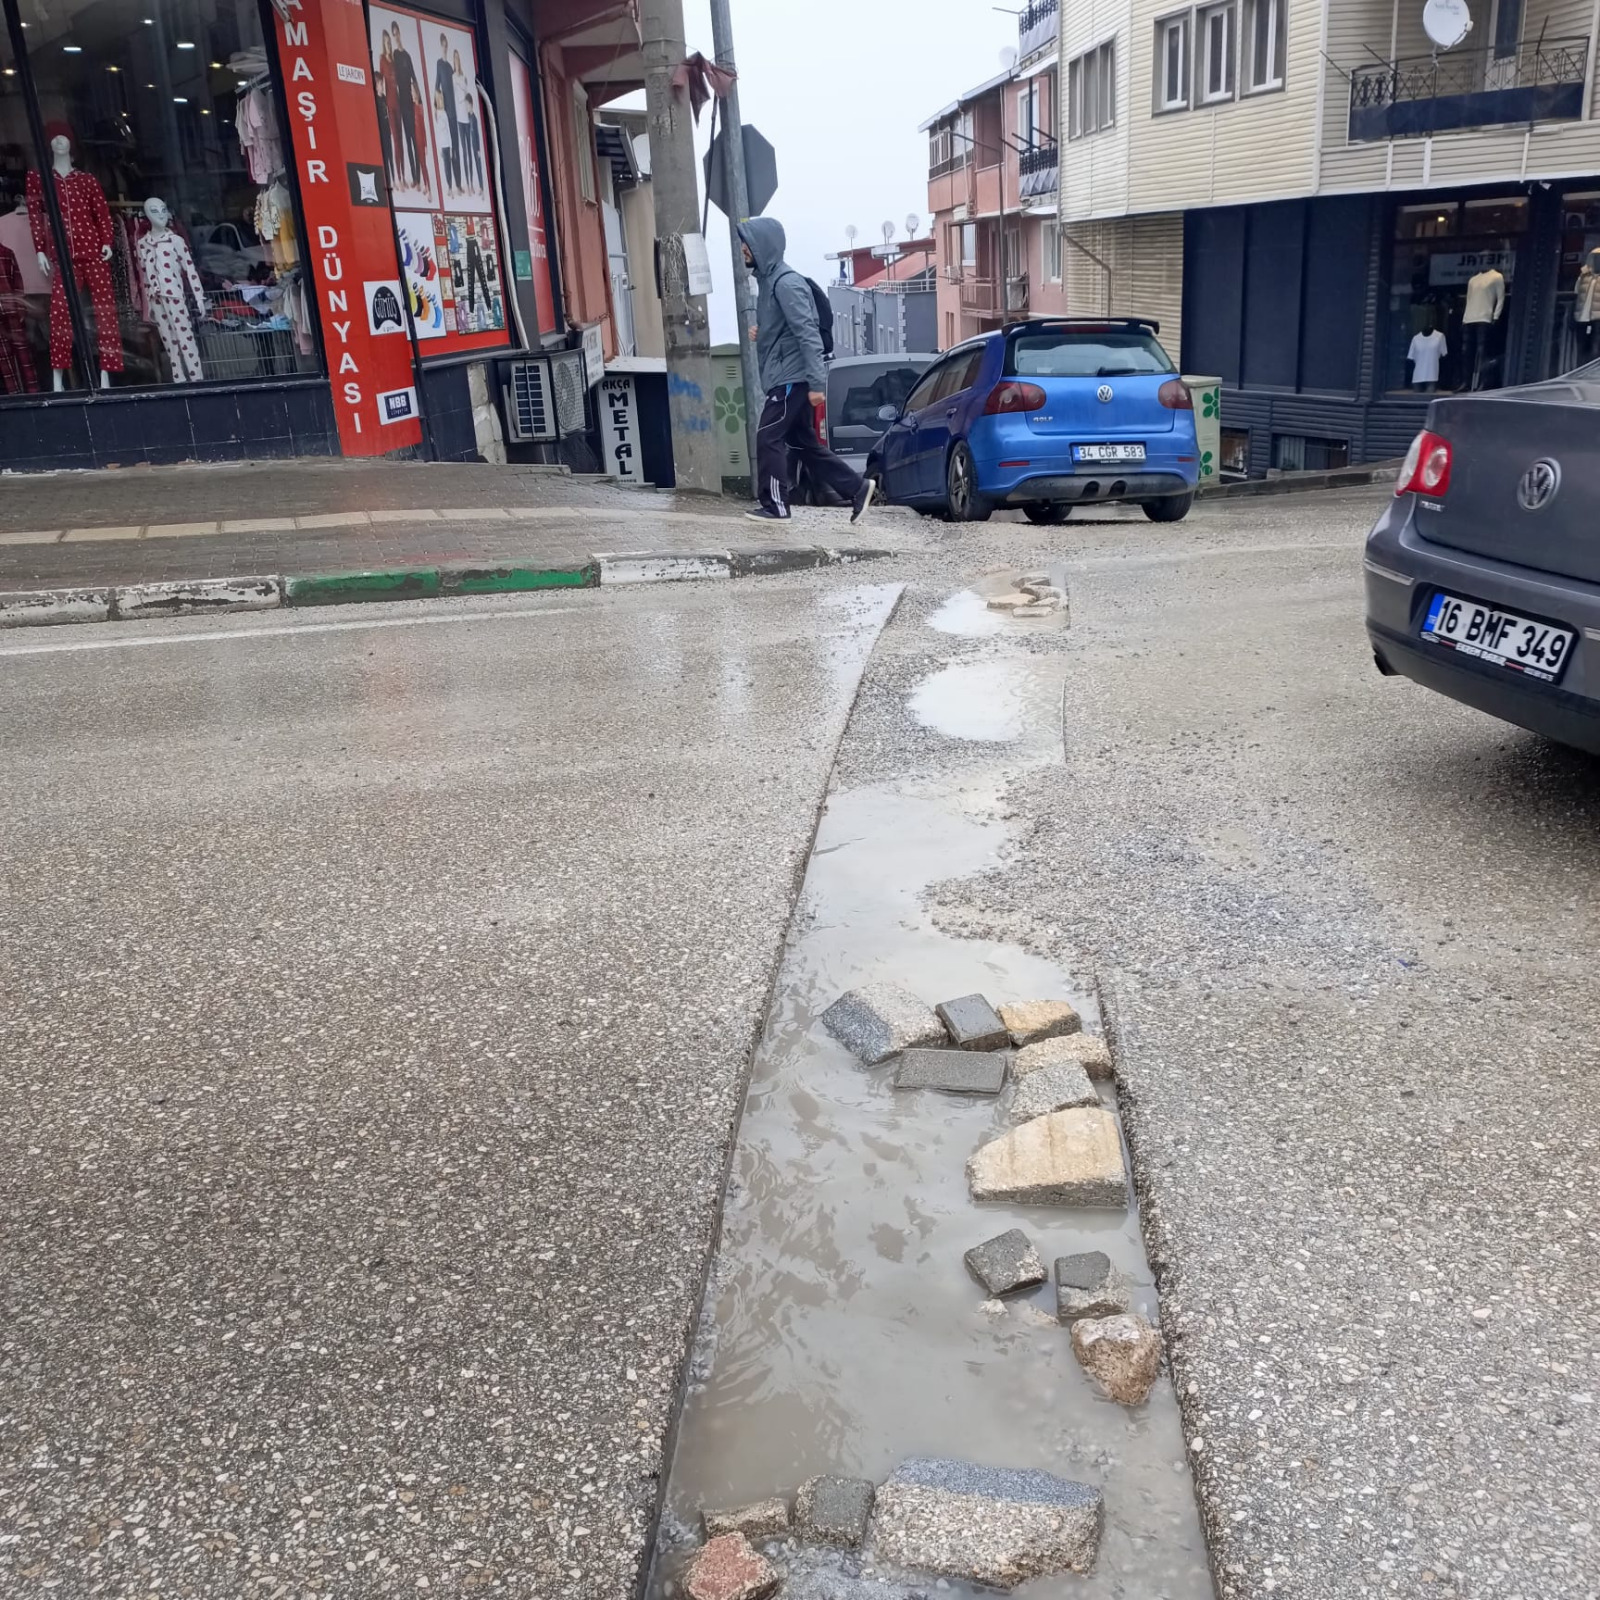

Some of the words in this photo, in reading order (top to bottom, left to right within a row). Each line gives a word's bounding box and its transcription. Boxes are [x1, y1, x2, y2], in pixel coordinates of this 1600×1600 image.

[317, 225, 362, 433] DÜNYASI
[602, 379, 631, 391] AKÇA
[608, 392, 633, 475] METAL
[1080, 447, 1093, 459] 34
[1098, 446, 1118, 458] CGR
[1123, 446, 1143, 457] 583
[1438, 600, 1462, 634] 16
[1466, 609, 1517, 649] BMF
[1517, 625, 1565, 667] 349
